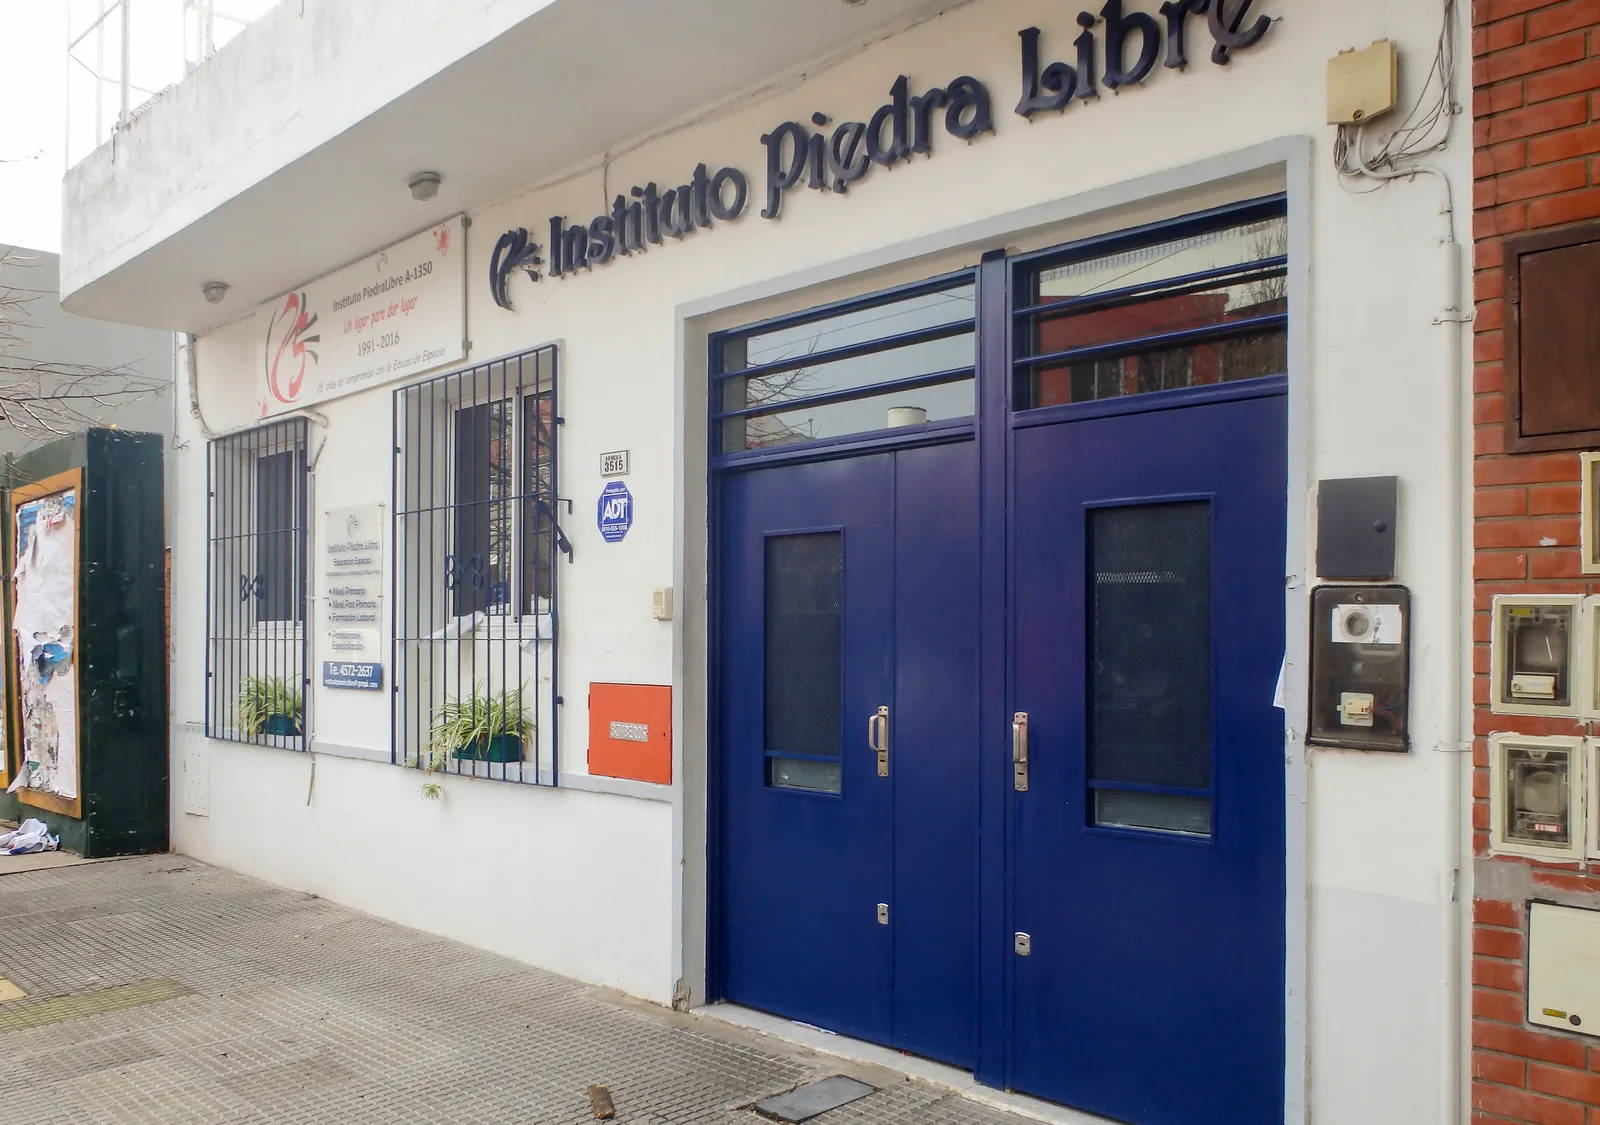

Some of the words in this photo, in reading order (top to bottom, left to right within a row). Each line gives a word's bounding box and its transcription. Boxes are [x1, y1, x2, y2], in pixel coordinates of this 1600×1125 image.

[548, 163, 748, 278] Instituto
[760, 75, 995, 220] Piedra
[1015, 0, 1274, 118] Libre
[333, 292, 361, 312] Instituto
[363, 275, 403, 300] PiedraLibre
[405, 261, 433, 283] A-1350
[344, 318, 353, 333] Un
[354, 315, 369, 333] lugar
[371, 309, 385, 328] para
[387, 301, 399, 317] dar
[400, 296, 418, 316] lugar
[358, 331, 400, 356] 1991-2016
[376, 367, 385, 376] con
[422, 344, 447, 363] Especial
[604, 460, 623, 472] 3515
[603, 498, 627, 520] ADT
[332, 587, 345, 596] Nivel
[345, 586, 366, 596] Primario
[356, 599, 377, 608] Primario
[339, 664, 374, 677] 4572-2637
